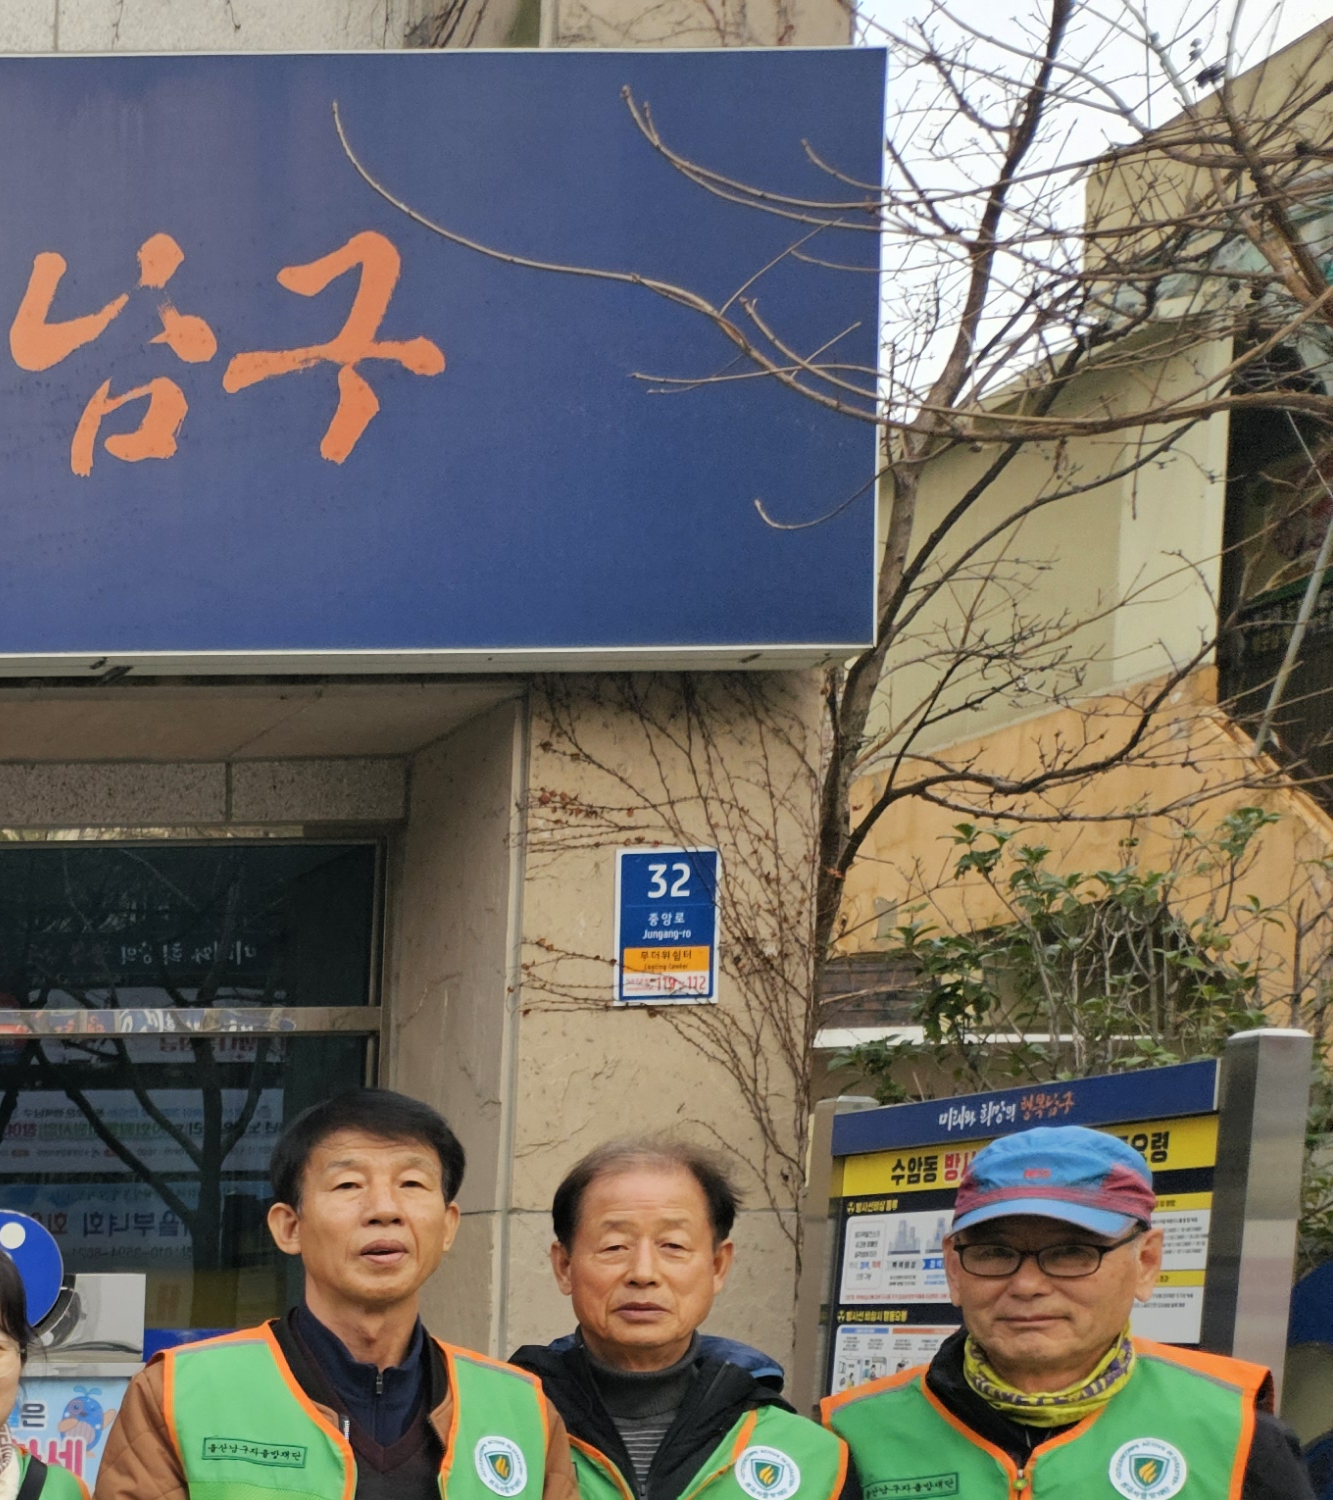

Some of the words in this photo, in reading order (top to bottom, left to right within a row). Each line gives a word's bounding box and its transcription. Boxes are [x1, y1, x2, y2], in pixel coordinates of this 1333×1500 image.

[648, 863, 691, 898] 32
[648, 912, 685, 926] 중앙로
[643, 929, 691, 940] Jungang-ro
[641, 950, 691, 961] 무더위쉼터
[939, 1105, 976, 1131] 미래와
[980, 1101, 1016, 1127] 희망의
[1021, 1091, 1074, 1120] 행복남구
[891, 1155, 938, 1185] 수암동
